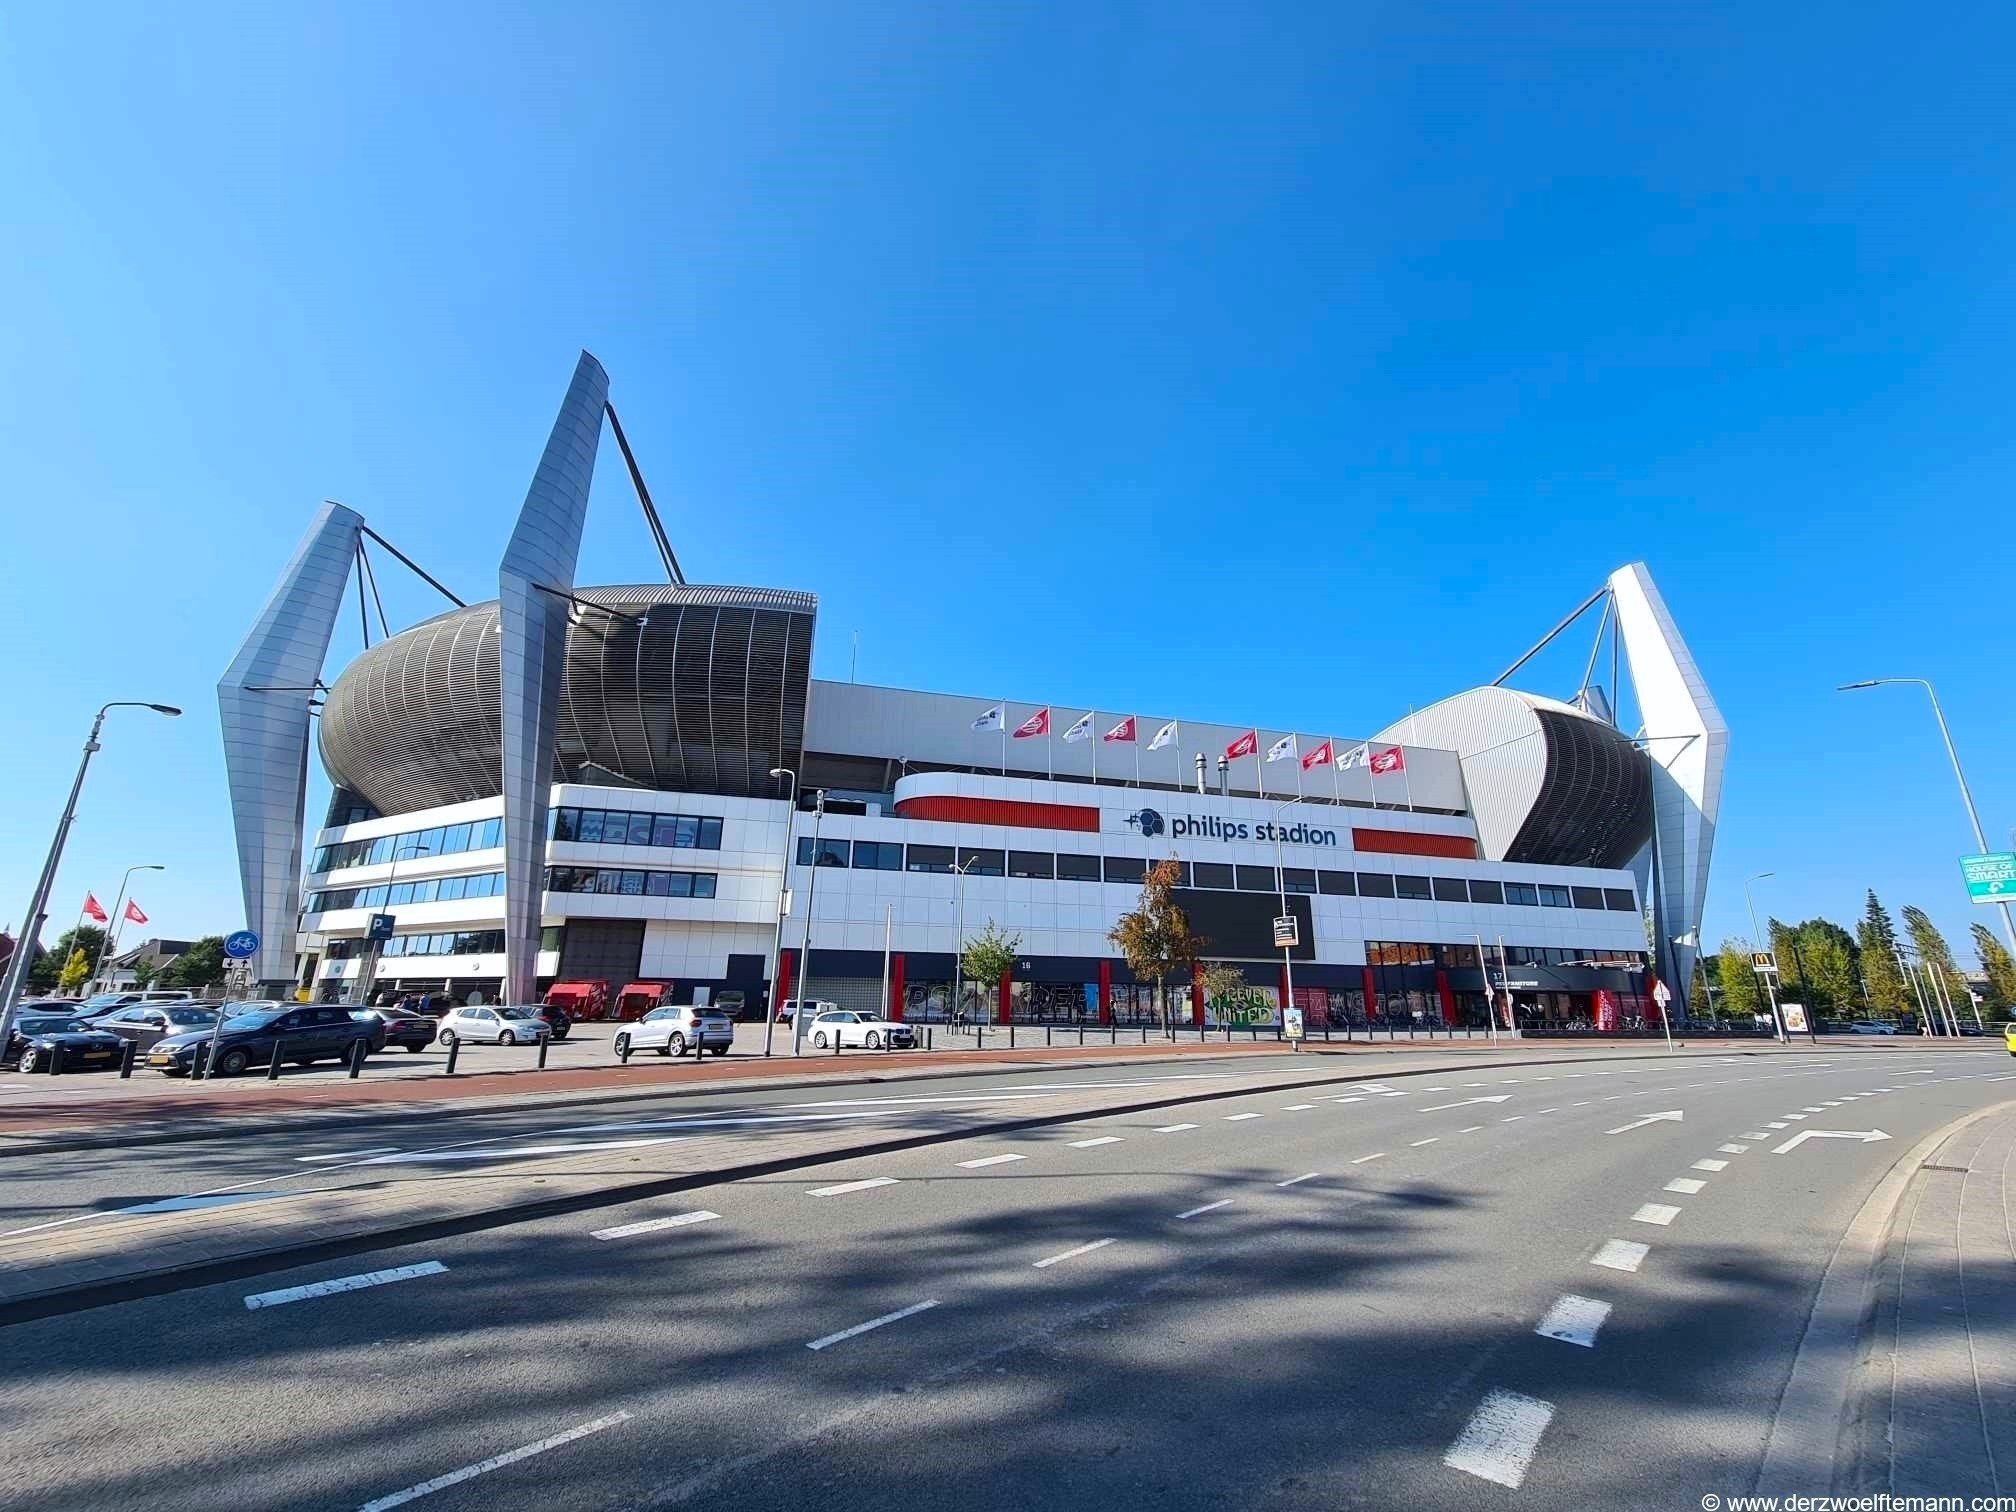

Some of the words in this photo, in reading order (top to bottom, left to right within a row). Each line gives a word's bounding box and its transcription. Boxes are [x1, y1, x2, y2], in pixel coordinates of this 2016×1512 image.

[1172, 814, 1249, 843] philips
[1255, 821, 1337, 846] stadion
[373, 918, 382, 930] P
